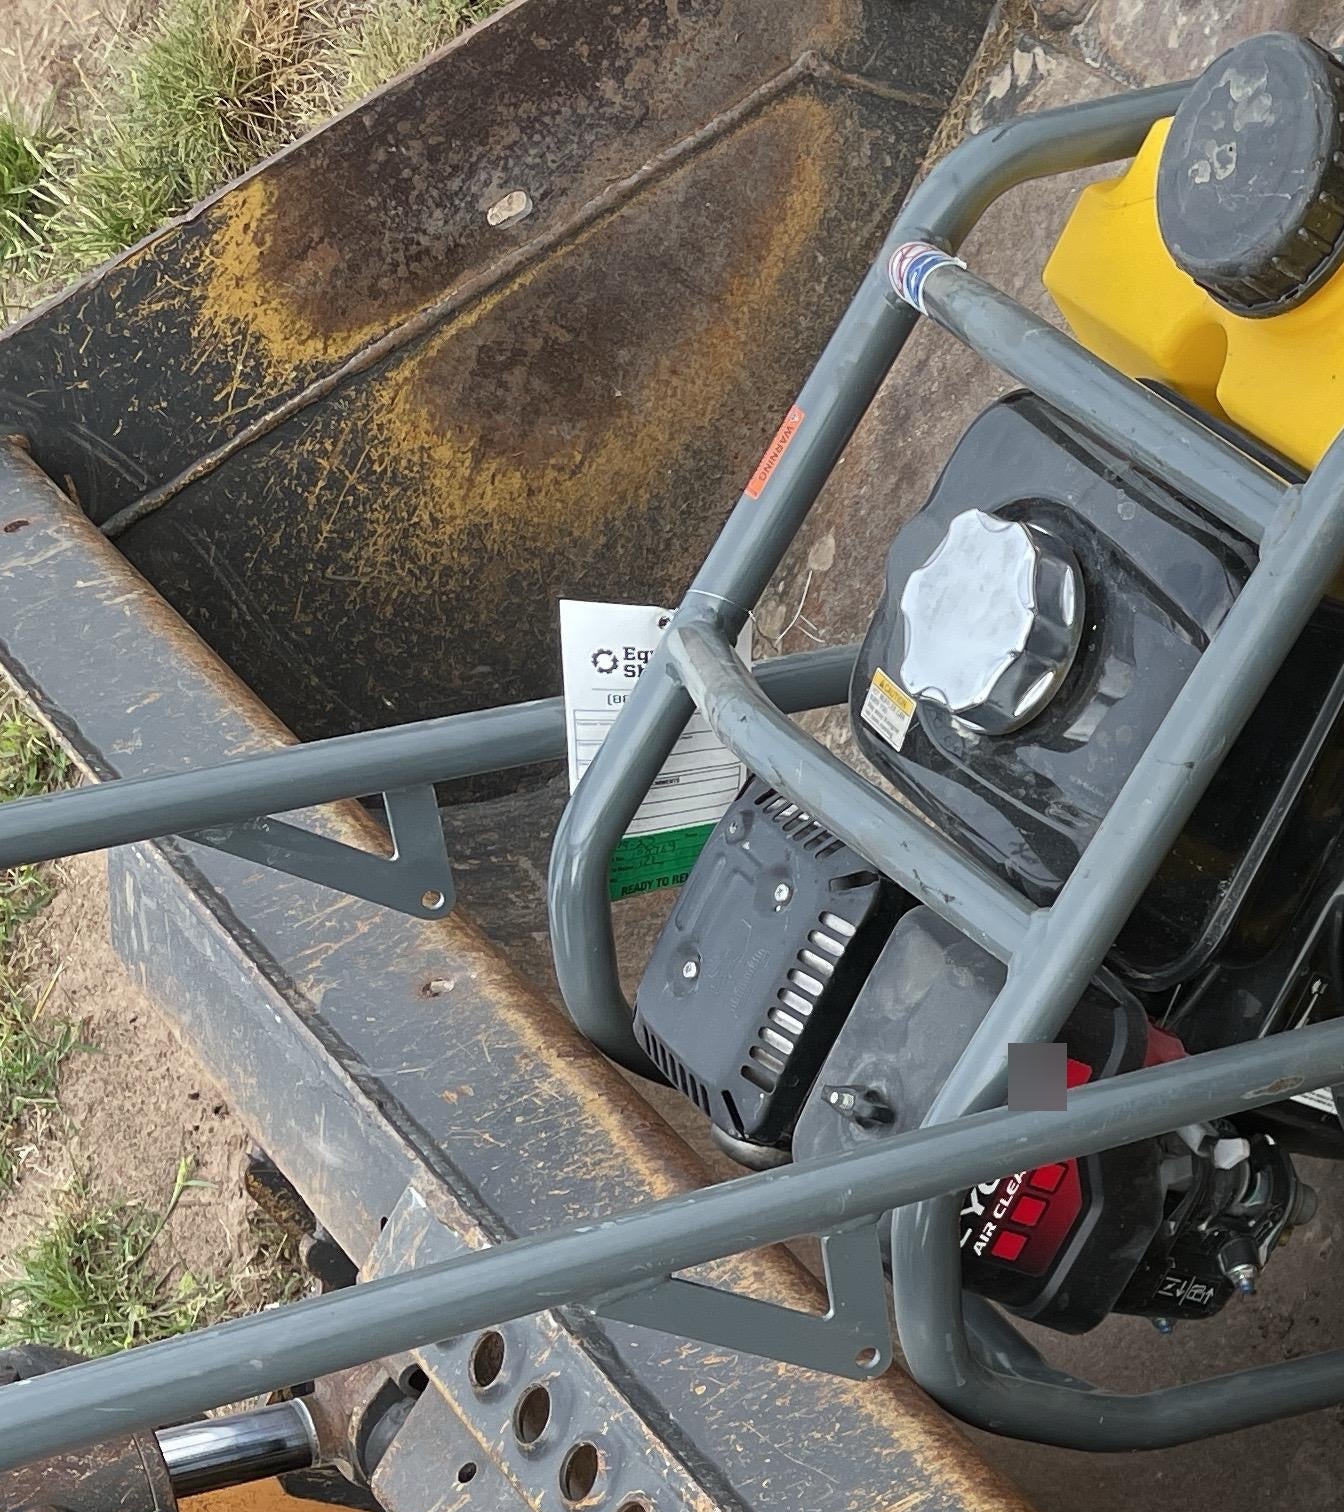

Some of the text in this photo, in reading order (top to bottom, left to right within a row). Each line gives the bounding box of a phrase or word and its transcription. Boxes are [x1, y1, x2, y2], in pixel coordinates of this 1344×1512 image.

[759, 425, 796, 482] WARNING
[621, 879, 652, 897] READY
[656, 876, 669, 888] TO
[972, 1170, 1027, 1257] AIR CLEA
